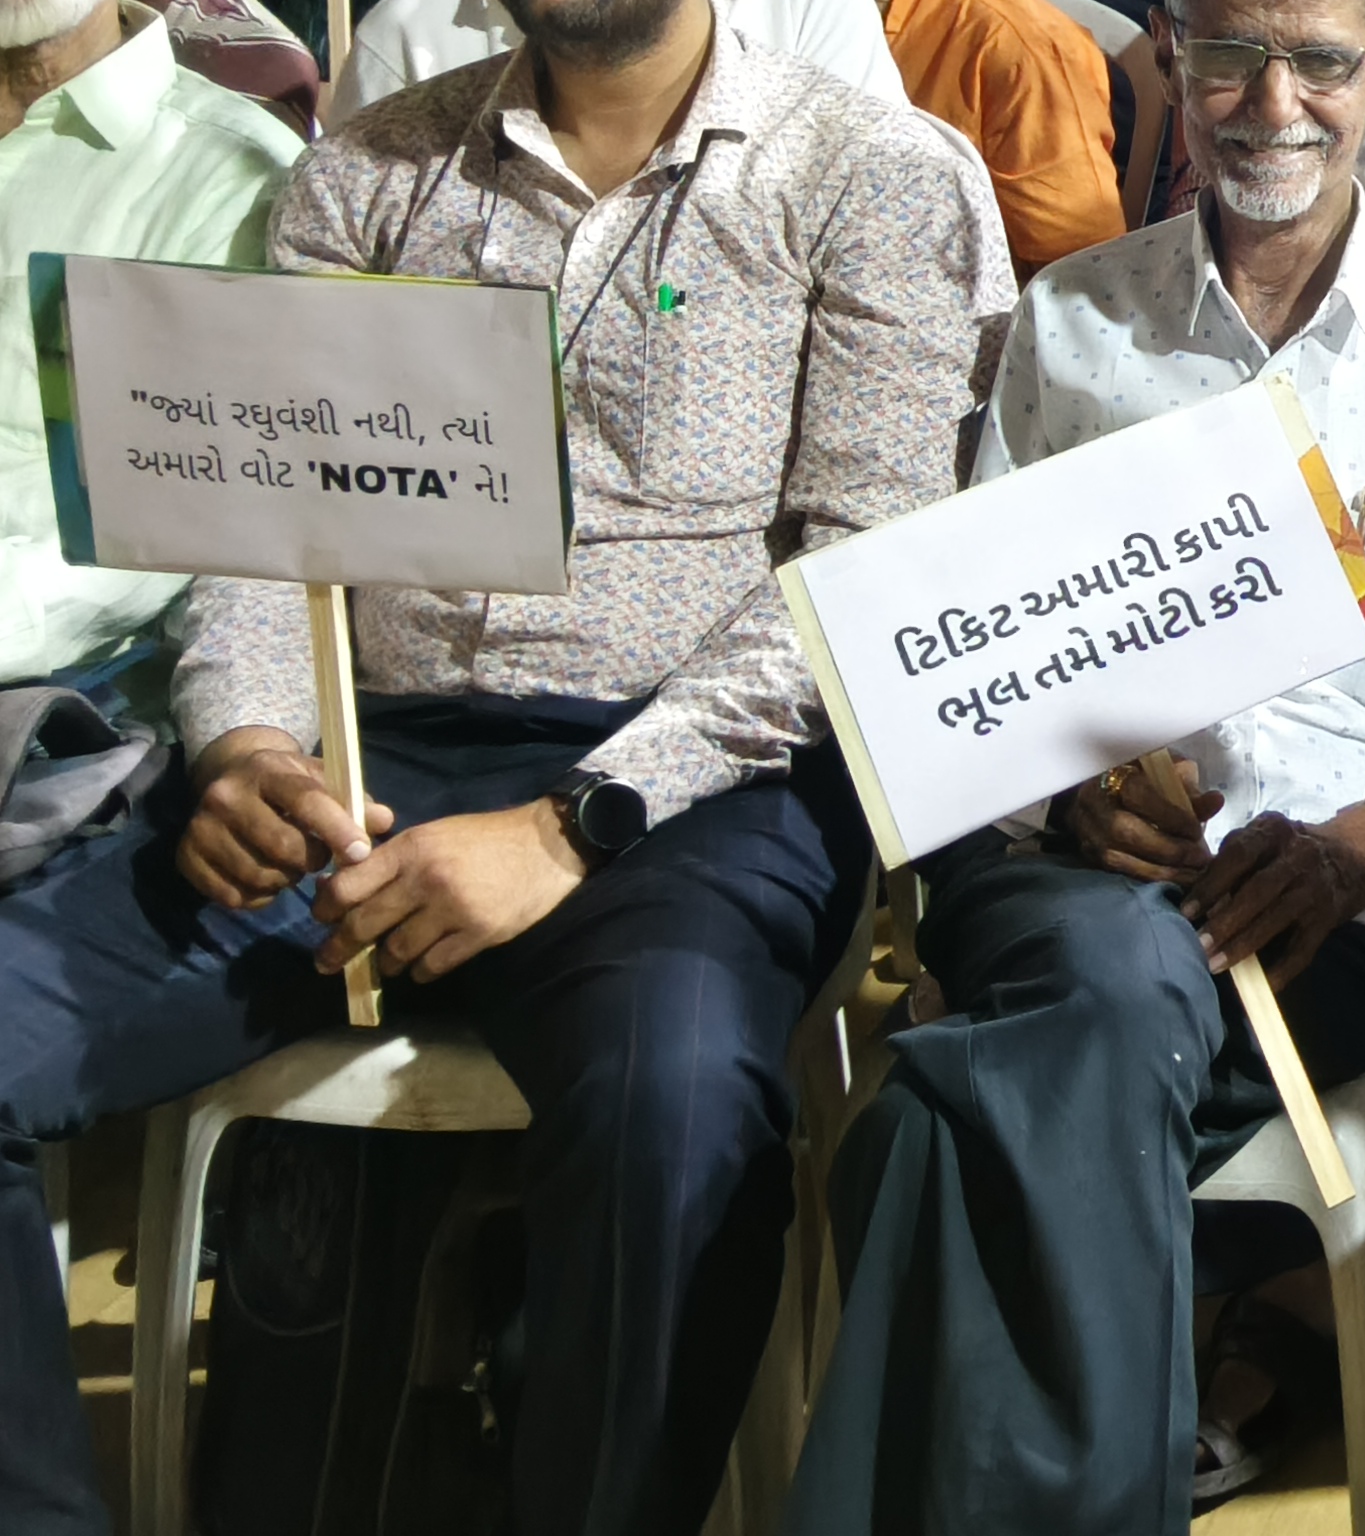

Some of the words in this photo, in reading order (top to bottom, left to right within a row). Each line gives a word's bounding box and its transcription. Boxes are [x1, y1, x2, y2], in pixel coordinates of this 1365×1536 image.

[127, 445, 227, 483] અમારો
[240, 448, 294, 488] વોટ
[308, 460, 457, 499] 'NOTA'
[475, 464, 508, 503] ને!
[131, 390, 218, 426] "જ્યાં
[231, 398, 340, 441] રઘુવંશી
[353, 403, 425, 446] નથી,
[442, 418, 493, 445] ત્યાં
[894, 604, 1021, 676] ટિકિટ
[1020, 532, 1171, 616] અમારી
[1174, 493, 1270, 564] કાપી
[937, 671, 1030, 736] ભૂલ
[1034, 626, 1107, 690] તમે
[1106, 587, 1206, 654] મોટી
[1209, 556, 1283, 620] કરી
